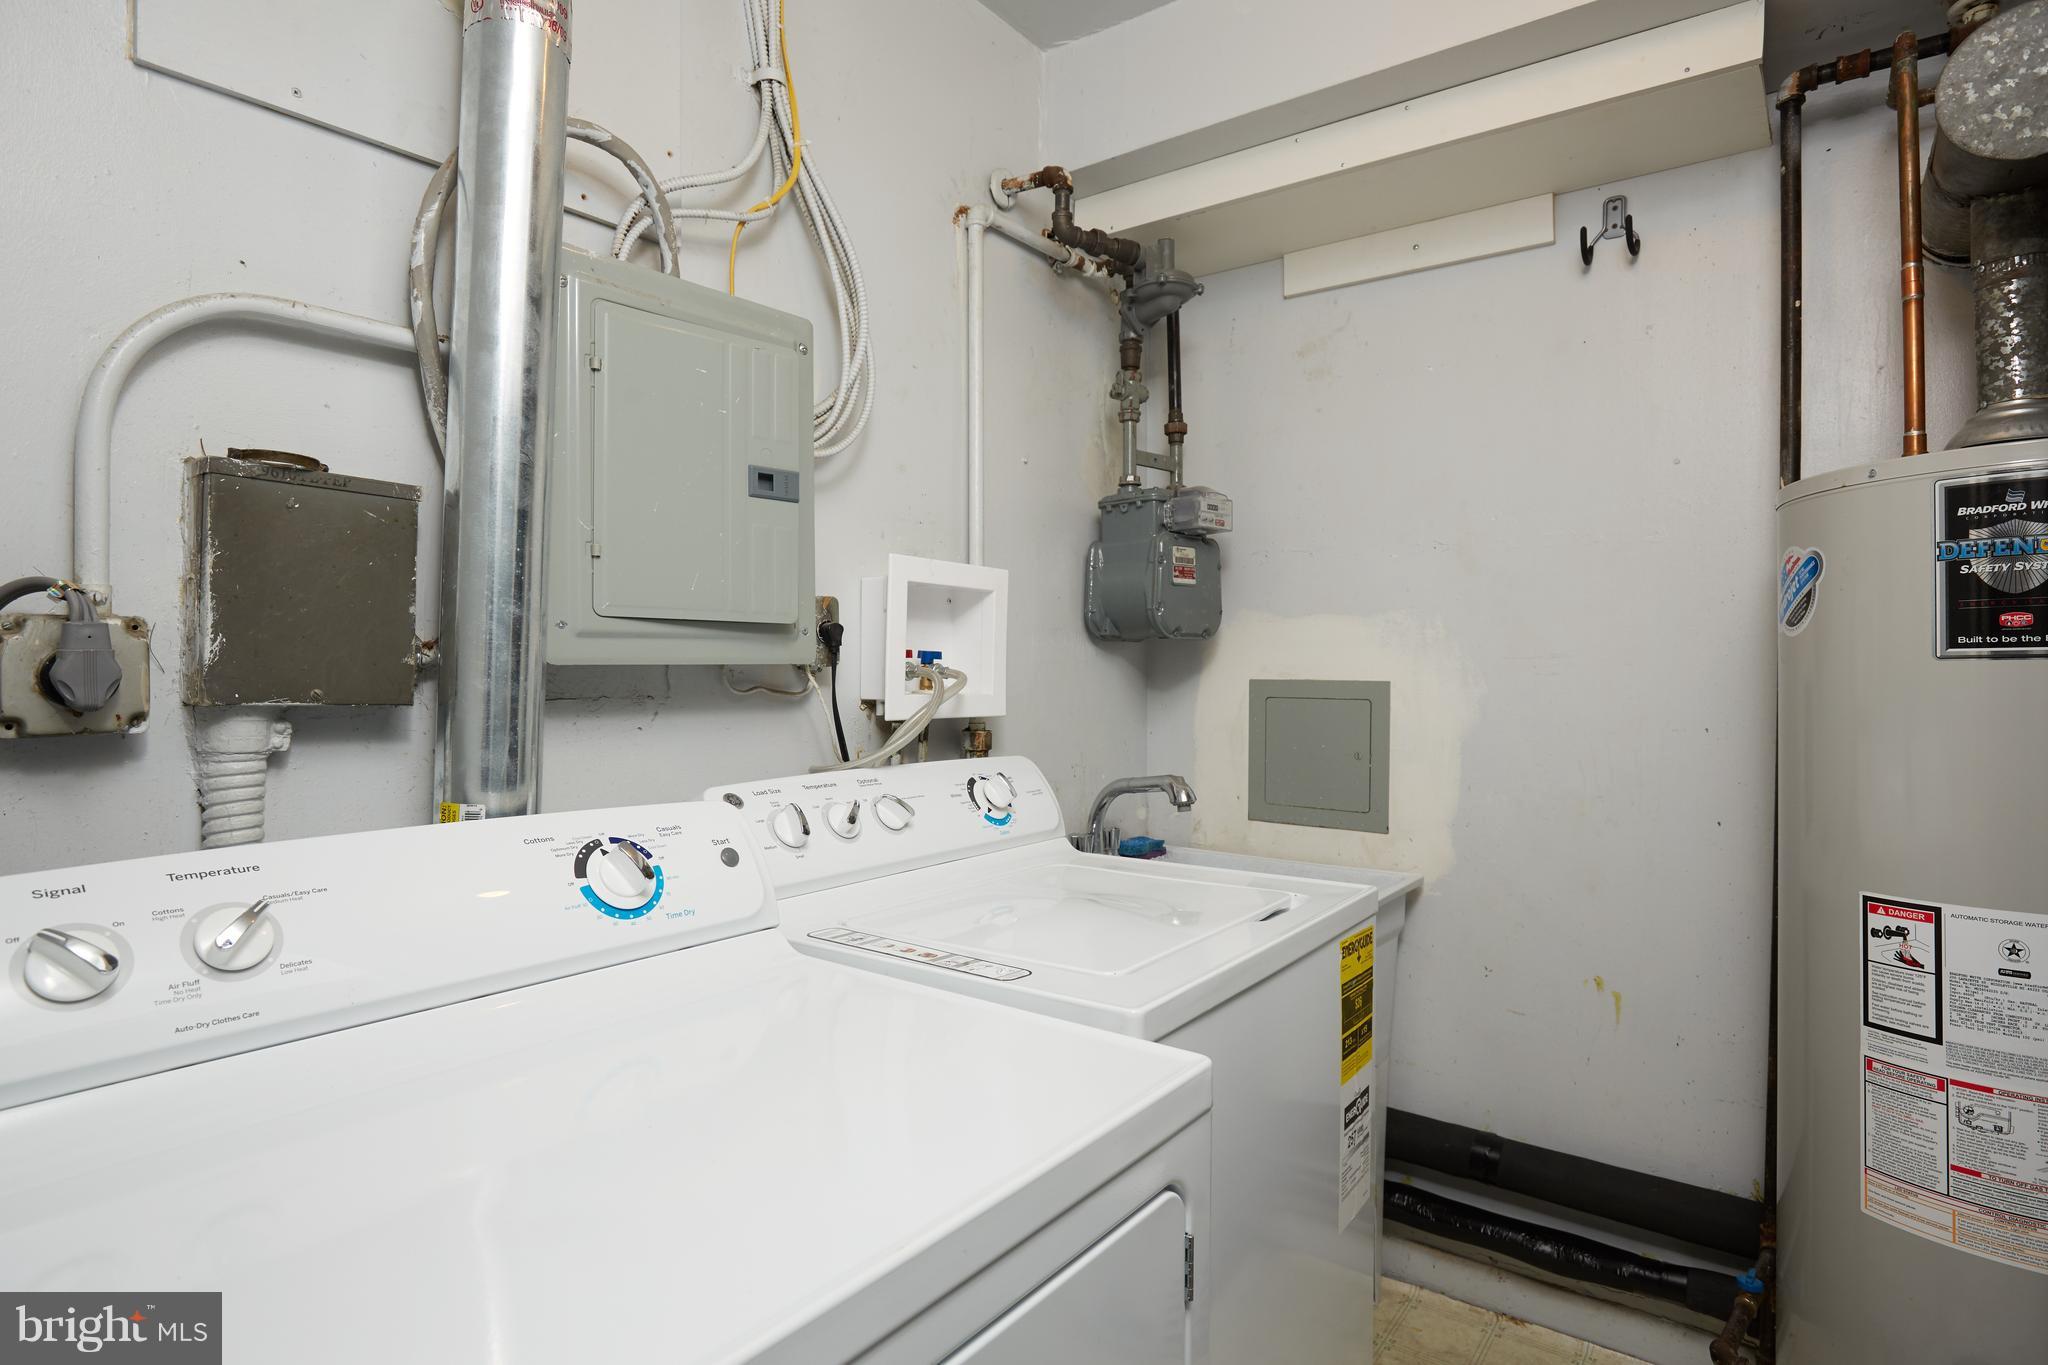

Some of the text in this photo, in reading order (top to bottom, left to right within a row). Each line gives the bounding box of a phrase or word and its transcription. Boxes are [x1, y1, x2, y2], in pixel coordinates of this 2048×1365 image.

[1957, 502, 2027, 516] BRADFORD
[1960, 562, 2012, 574] SAFETY
[1958, 636, 1983, 644] Built
[2021, 634, 2041, 642] the
[802, 782, 837, 791] Temperature
[656, 824, 682, 832] Casuals
[523, 836, 555, 845] Cottons
[711, 837, 730, 846] Start
[166, 863, 260, 883] Temperature
[32, 884, 86, 900] Signal
[262, 888, 310, 901] Casuals/Easy
[151, 907, 184, 917] Cottons
[665, 908, 696, 920] Time Dry
[1888, 908, 1926, 920] DANGER
[112, 920, 125, 928] On
[1950, 913, 1989, 923] AUTOMATIC
[1989, 918, 2024, 927] STORAGE
[5, 936, 20, 944] Off
[279, 959, 313, 970] Delicates
[168, 979, 201, 991] Air Fluff
[174, 1010, 261, 1034] Auto-Dry Clothes Care
[1999, 1177, 2015, 1185] TURN
